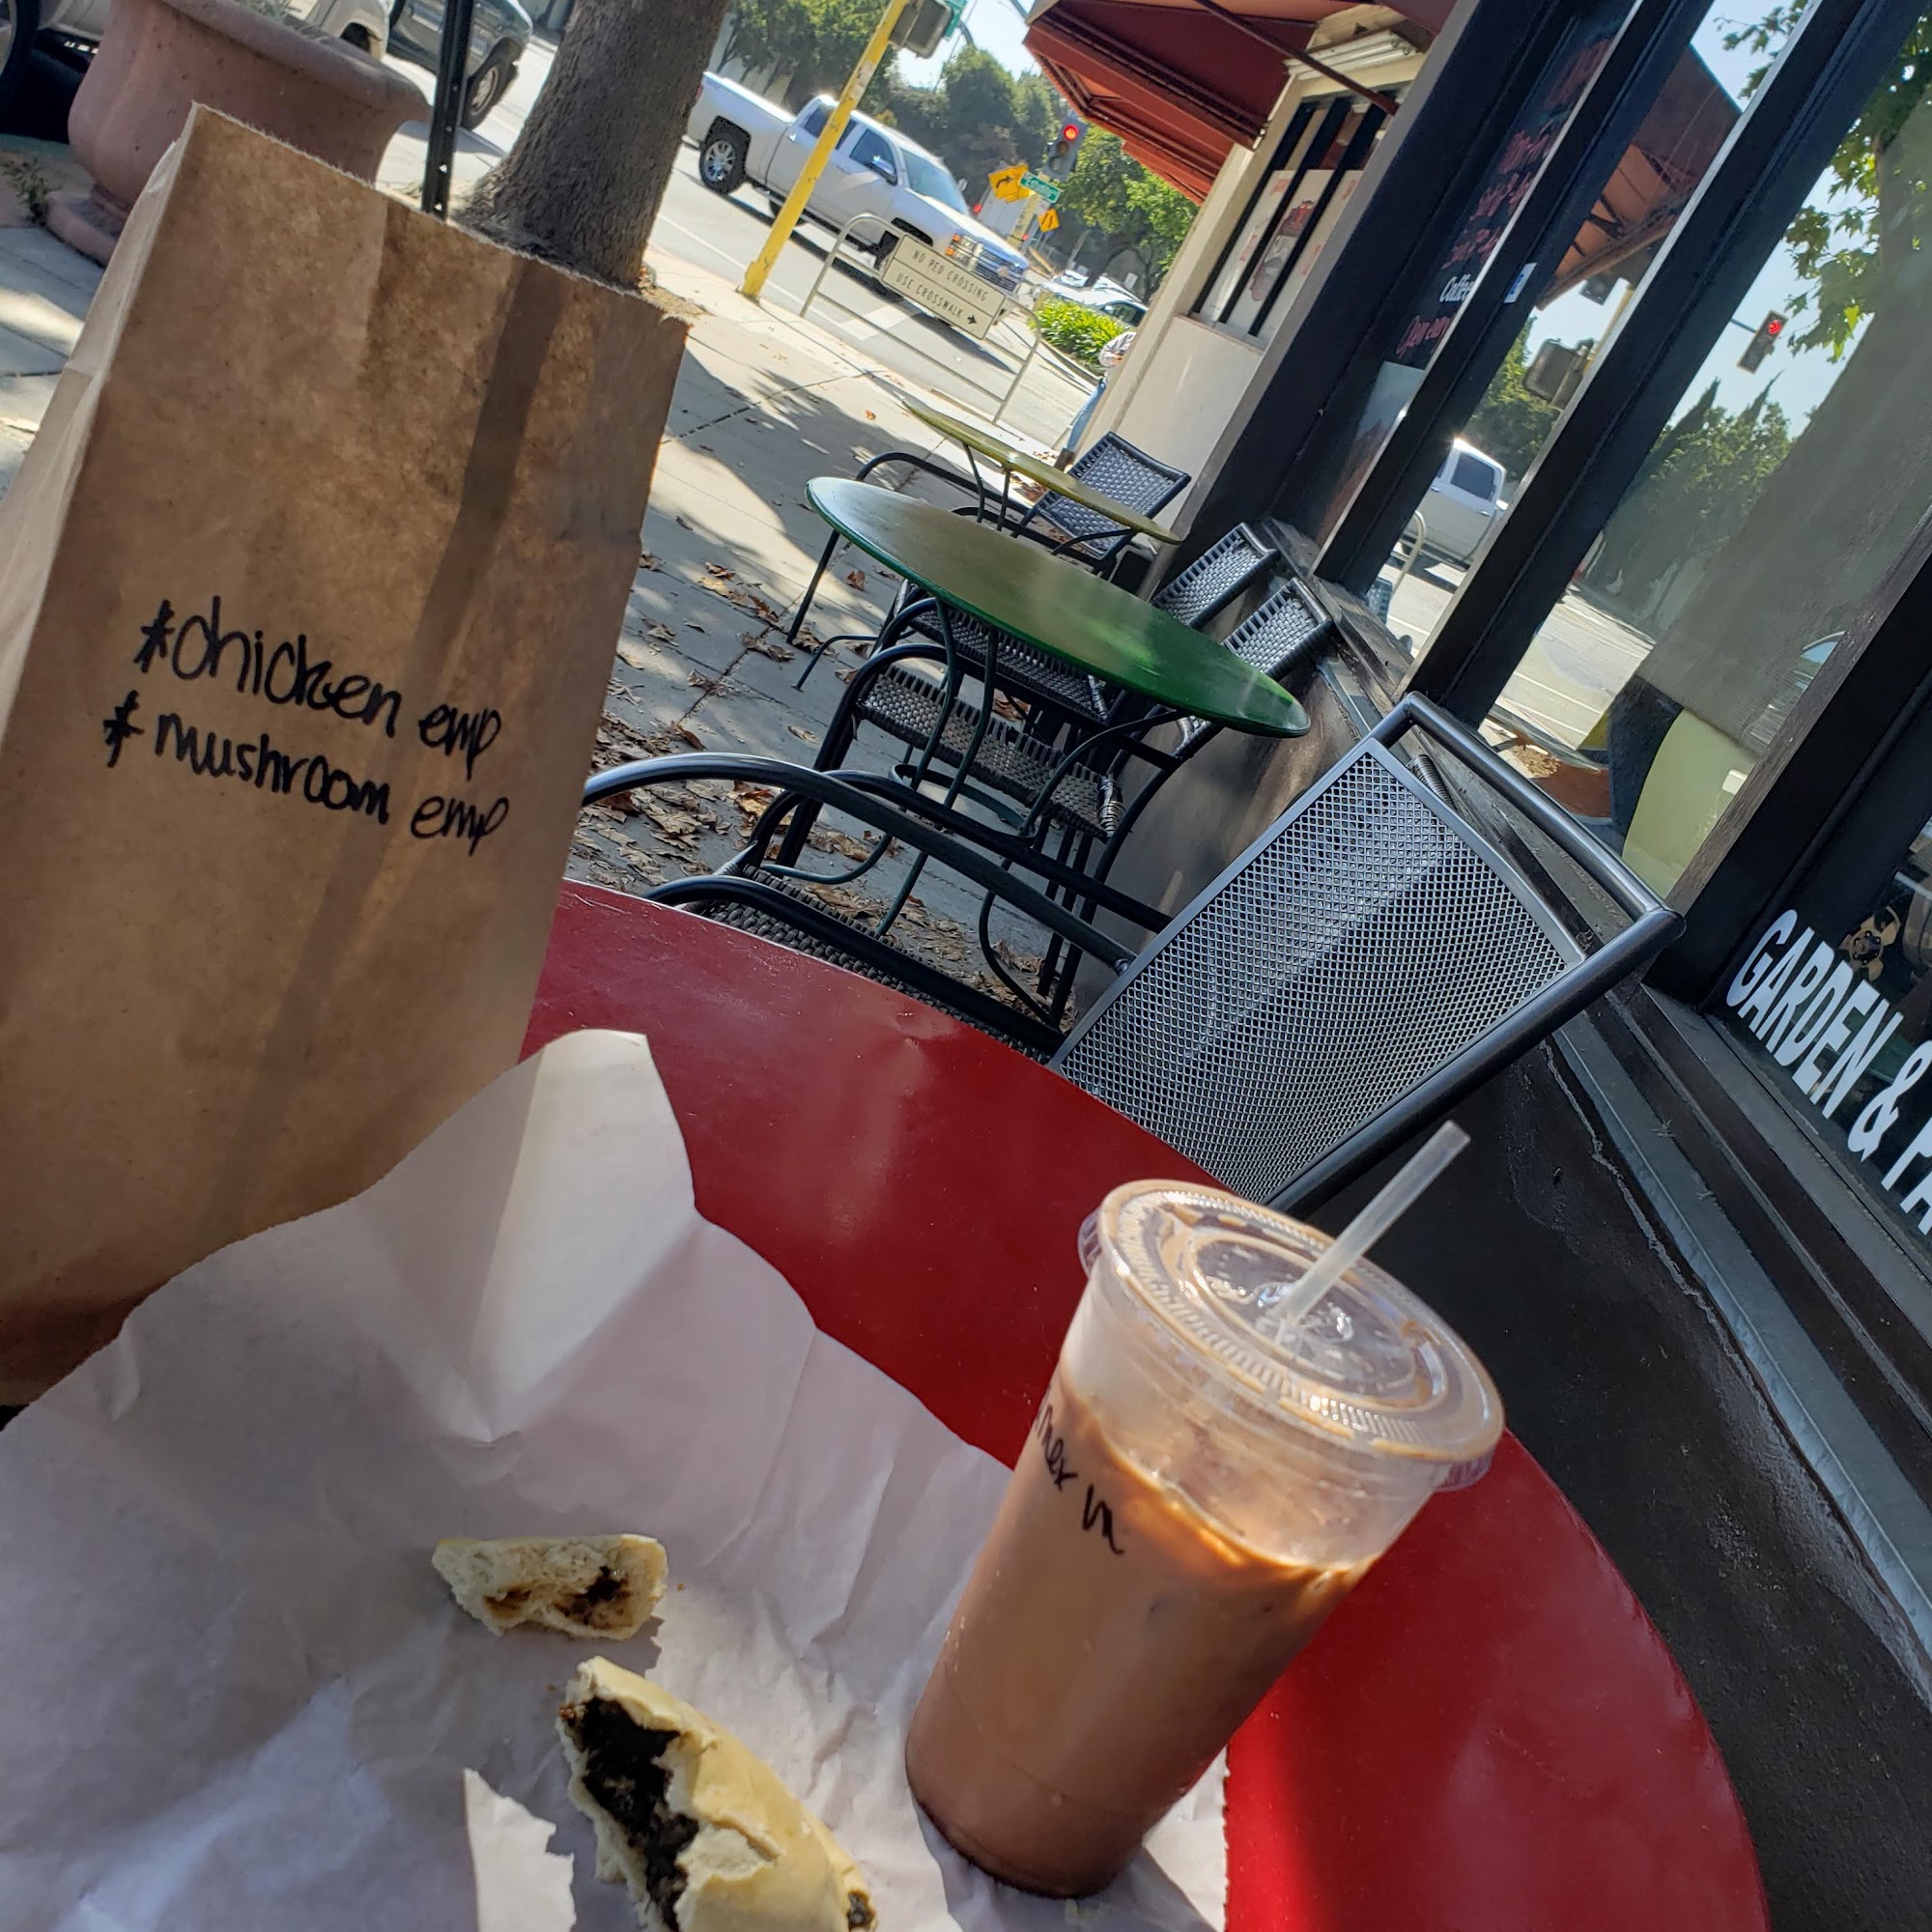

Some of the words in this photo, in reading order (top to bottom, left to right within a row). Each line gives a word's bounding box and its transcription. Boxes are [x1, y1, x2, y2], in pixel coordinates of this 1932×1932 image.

[896, 272, 914, 290] USE
[916, 284, 964, 319] CROSSWALK
[912, 250, 925, 264] NO
[928, 259, 945, 275] PED
[947, 270, 988, 301] CROSSING
[418, 703, 502, 781] emp
[411, 795, 509, 857] emp
[1726, 909, 1904, 1120] GARDEN
[1847, 1039, 1932, 1162] &
